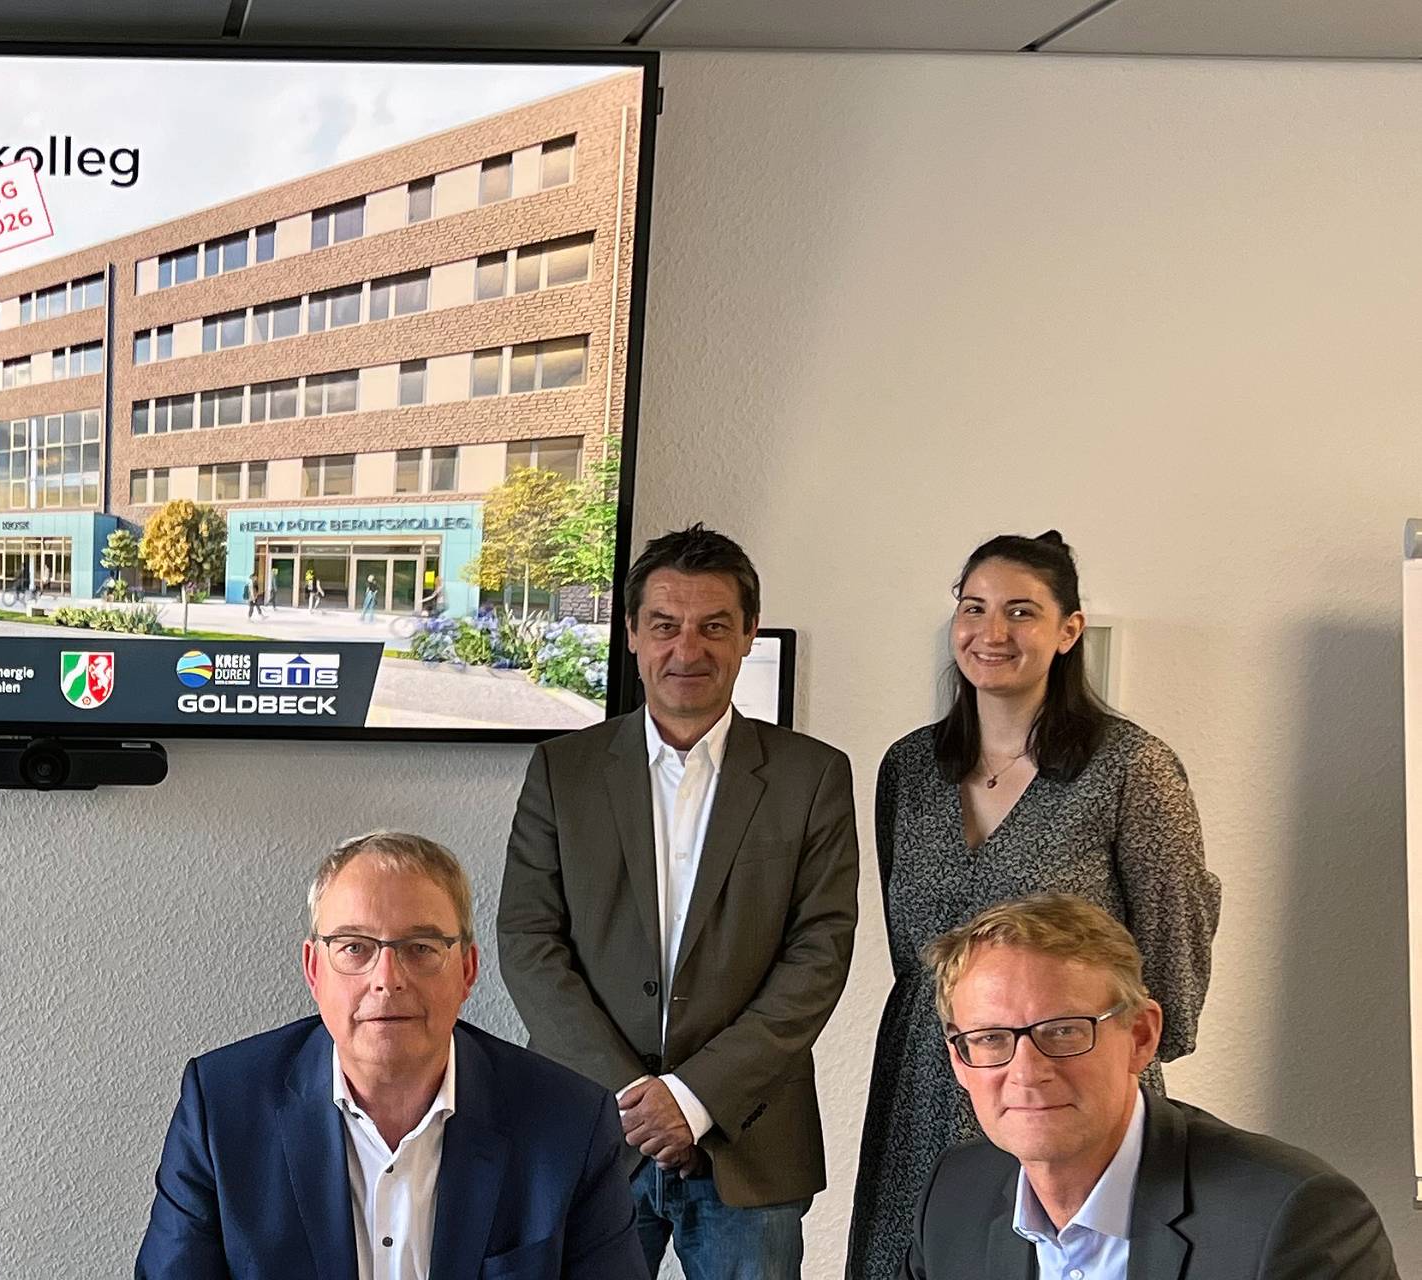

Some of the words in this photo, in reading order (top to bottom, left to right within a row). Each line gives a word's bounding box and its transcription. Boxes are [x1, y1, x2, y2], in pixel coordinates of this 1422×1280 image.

[214, 654, 251, 668] KREIS
[214, 667, 251, 680] DÜREN
[259, 666, 339, 686] GIS
[177, 693, 337, 716] GOLDBECK
